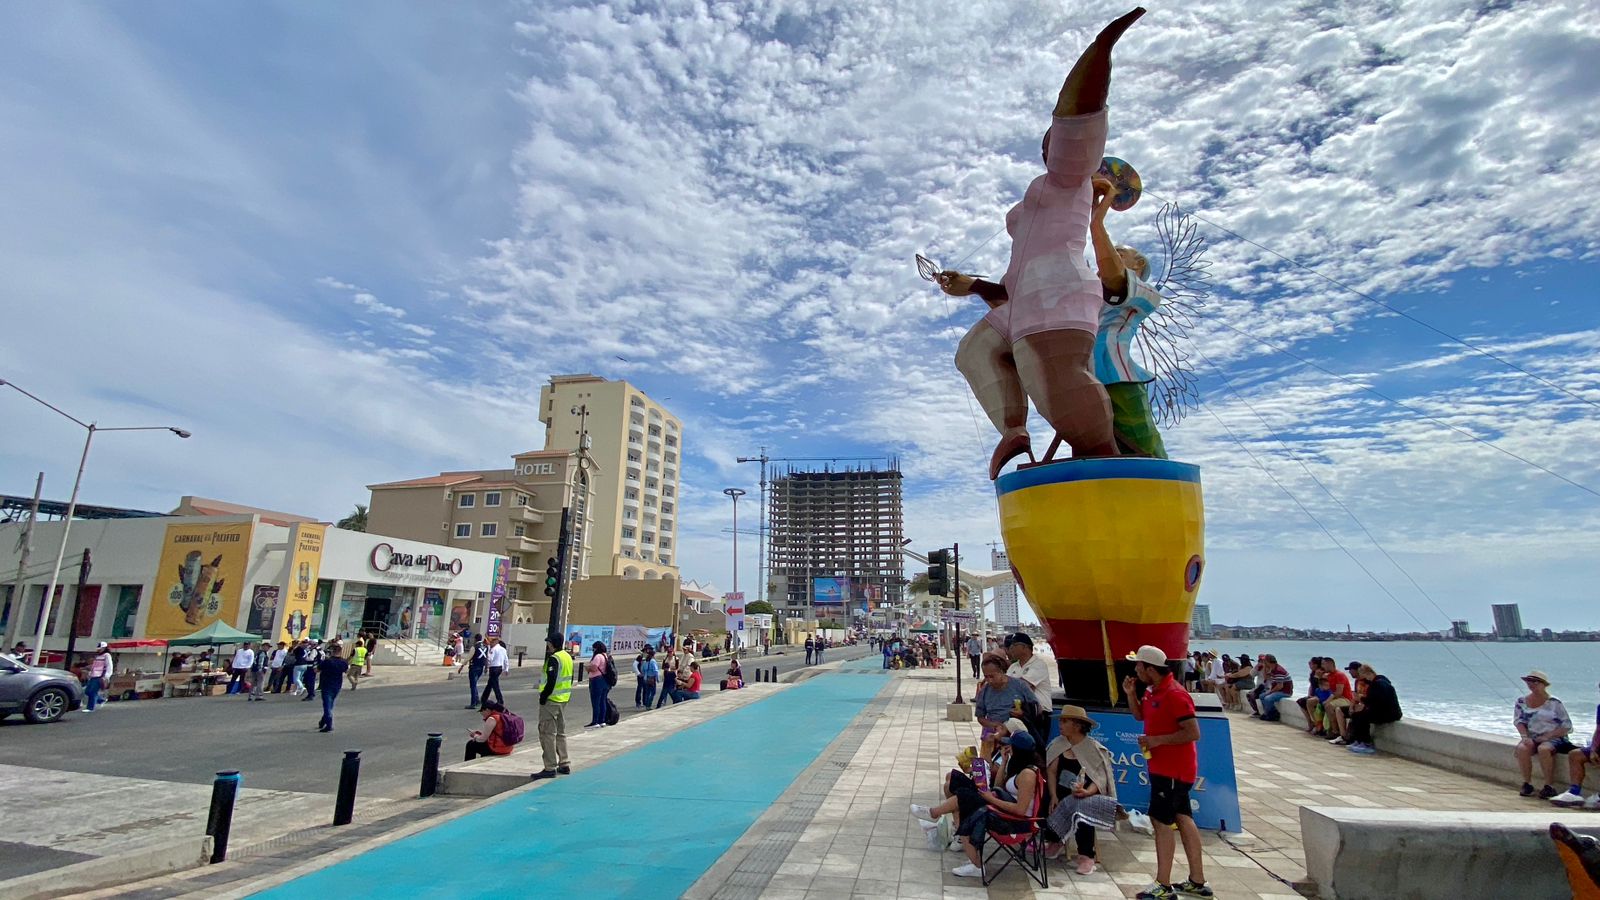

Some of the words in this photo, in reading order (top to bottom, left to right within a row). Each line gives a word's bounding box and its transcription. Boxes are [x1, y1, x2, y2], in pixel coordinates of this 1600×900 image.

[514, 463, 556, 476] HOTEL
[370, 543, 413, 572] Cava
[613, 641, 632, 651] ETAPA
[633, 640, 645, 650] CER
